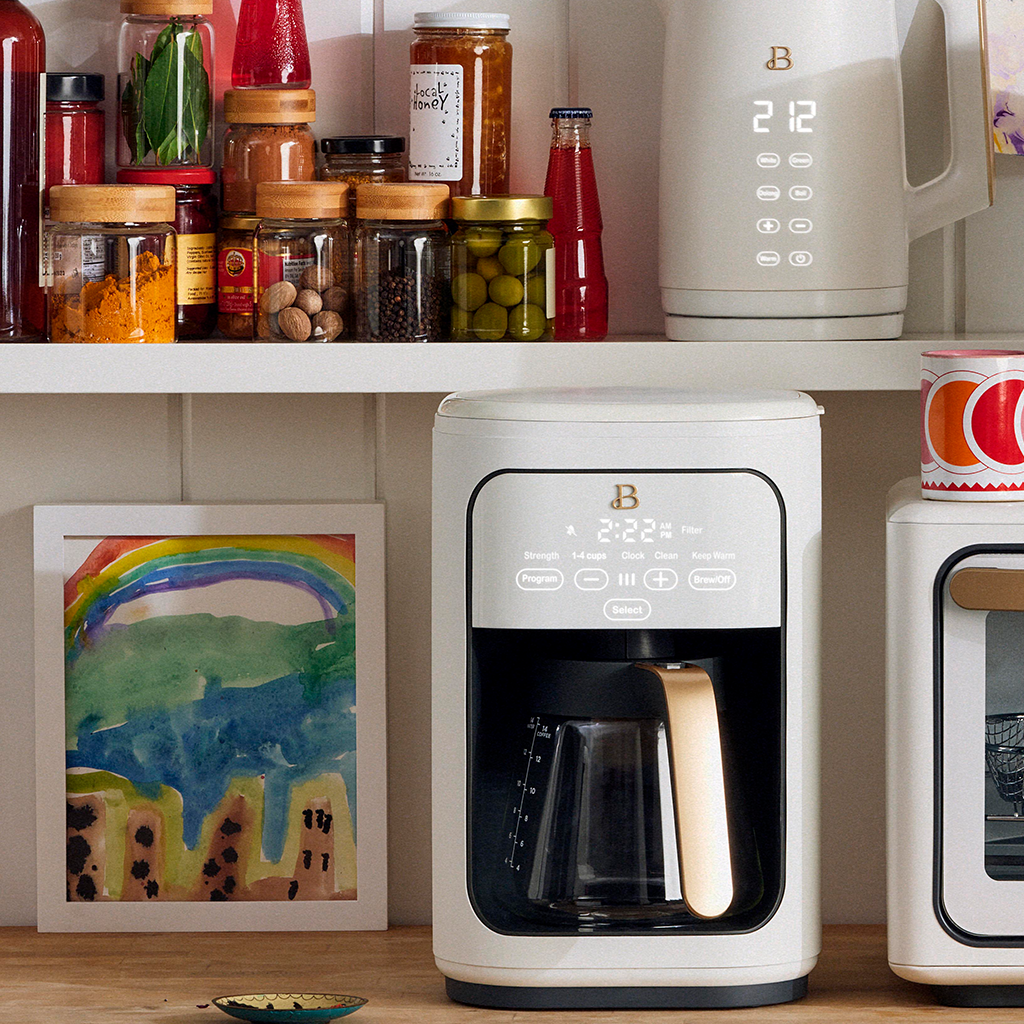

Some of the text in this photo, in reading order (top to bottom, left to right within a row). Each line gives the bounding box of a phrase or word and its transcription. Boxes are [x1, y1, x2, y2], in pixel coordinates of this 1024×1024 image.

[608, 483, 640, 511] B
[597, 518, 657, 543] 2:22
[659, 522, 672, 530] AM
[681, 525, 703, 534] Filter
[660, 531, 672, 539] PM
[523, 551, 560, 562] Strength
[572, 551, 607, 562] 1-4 cups
[621, 551, 645, 560] Clock
[654, 551, 679, 560] Clean
[692, 551, 736, 561] Keep Warm
[522, 574, 558, 585] Program
[693, 575, 731, 584] Brew/Off
[611, 605, 643, 615] Select
